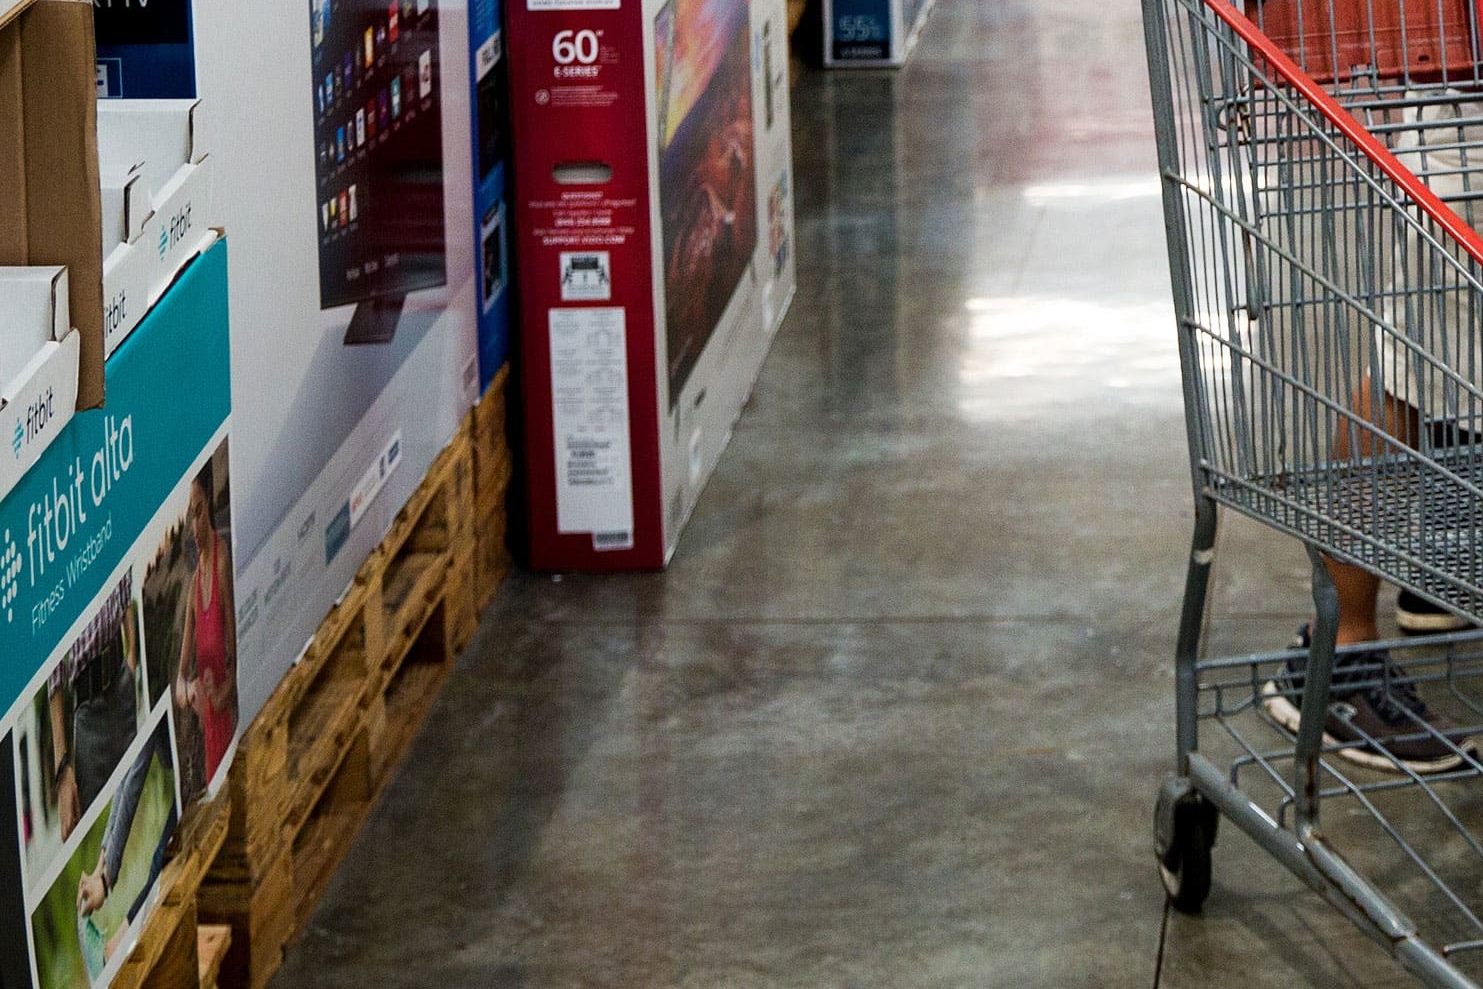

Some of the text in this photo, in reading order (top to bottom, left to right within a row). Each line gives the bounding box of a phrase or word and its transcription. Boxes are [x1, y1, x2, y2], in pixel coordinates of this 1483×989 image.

[169, 200, 192, 250] fitbit
[104, 289, 127, 339] itbit
[26, 386, 53, 445] fitbit
[26, 414, 133, 587] fitbit alta
[31, 511, 112, 637] Fitness Wristband
